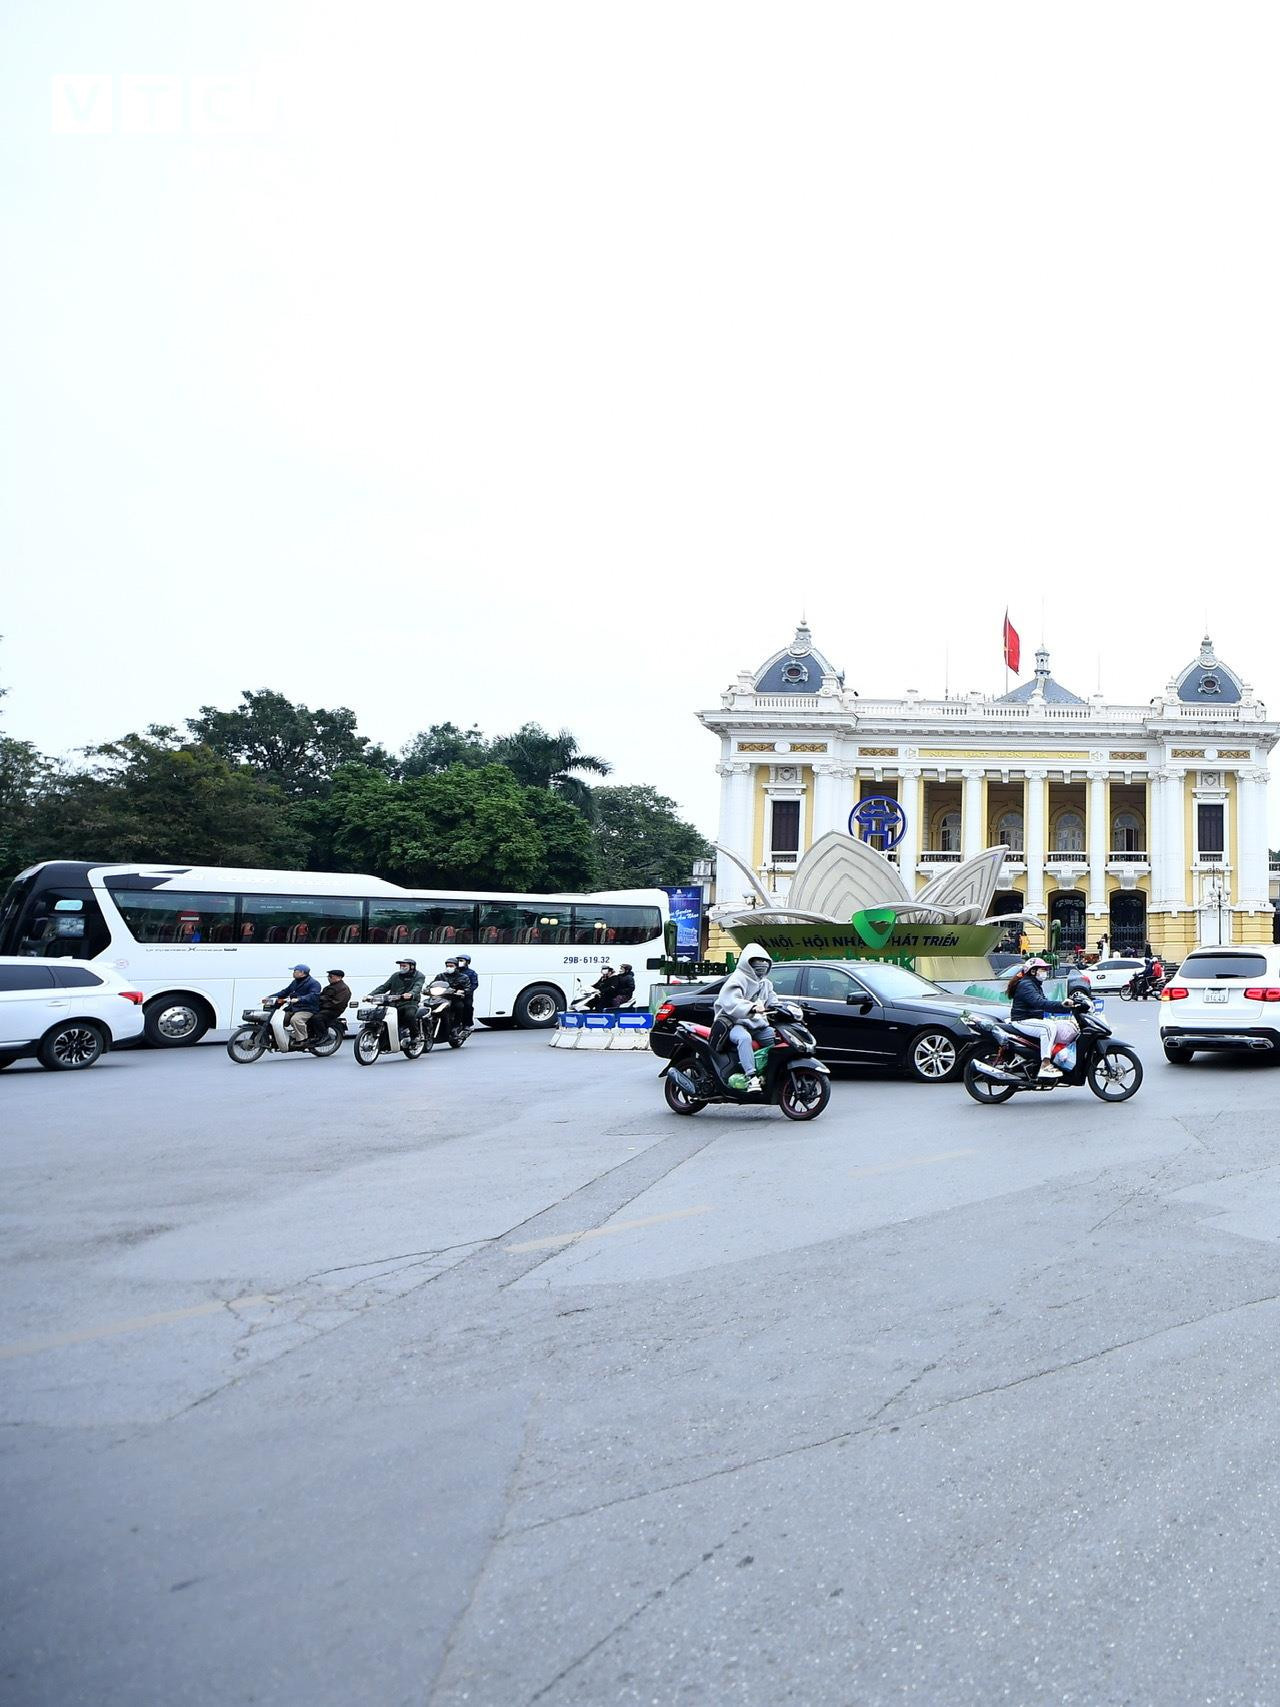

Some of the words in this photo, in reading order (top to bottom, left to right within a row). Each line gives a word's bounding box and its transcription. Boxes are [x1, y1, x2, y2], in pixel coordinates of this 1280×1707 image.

[769, 934, 794, 950] NỘI
[803, 934, 829, 950] HỘI
[833, 935, 866, 949] NHẬ
[890, 933, 919, 946] HÁT
[923, 931, 959, 947] TRIỂN
[563, 956, 610, 964] 29B-619.32
